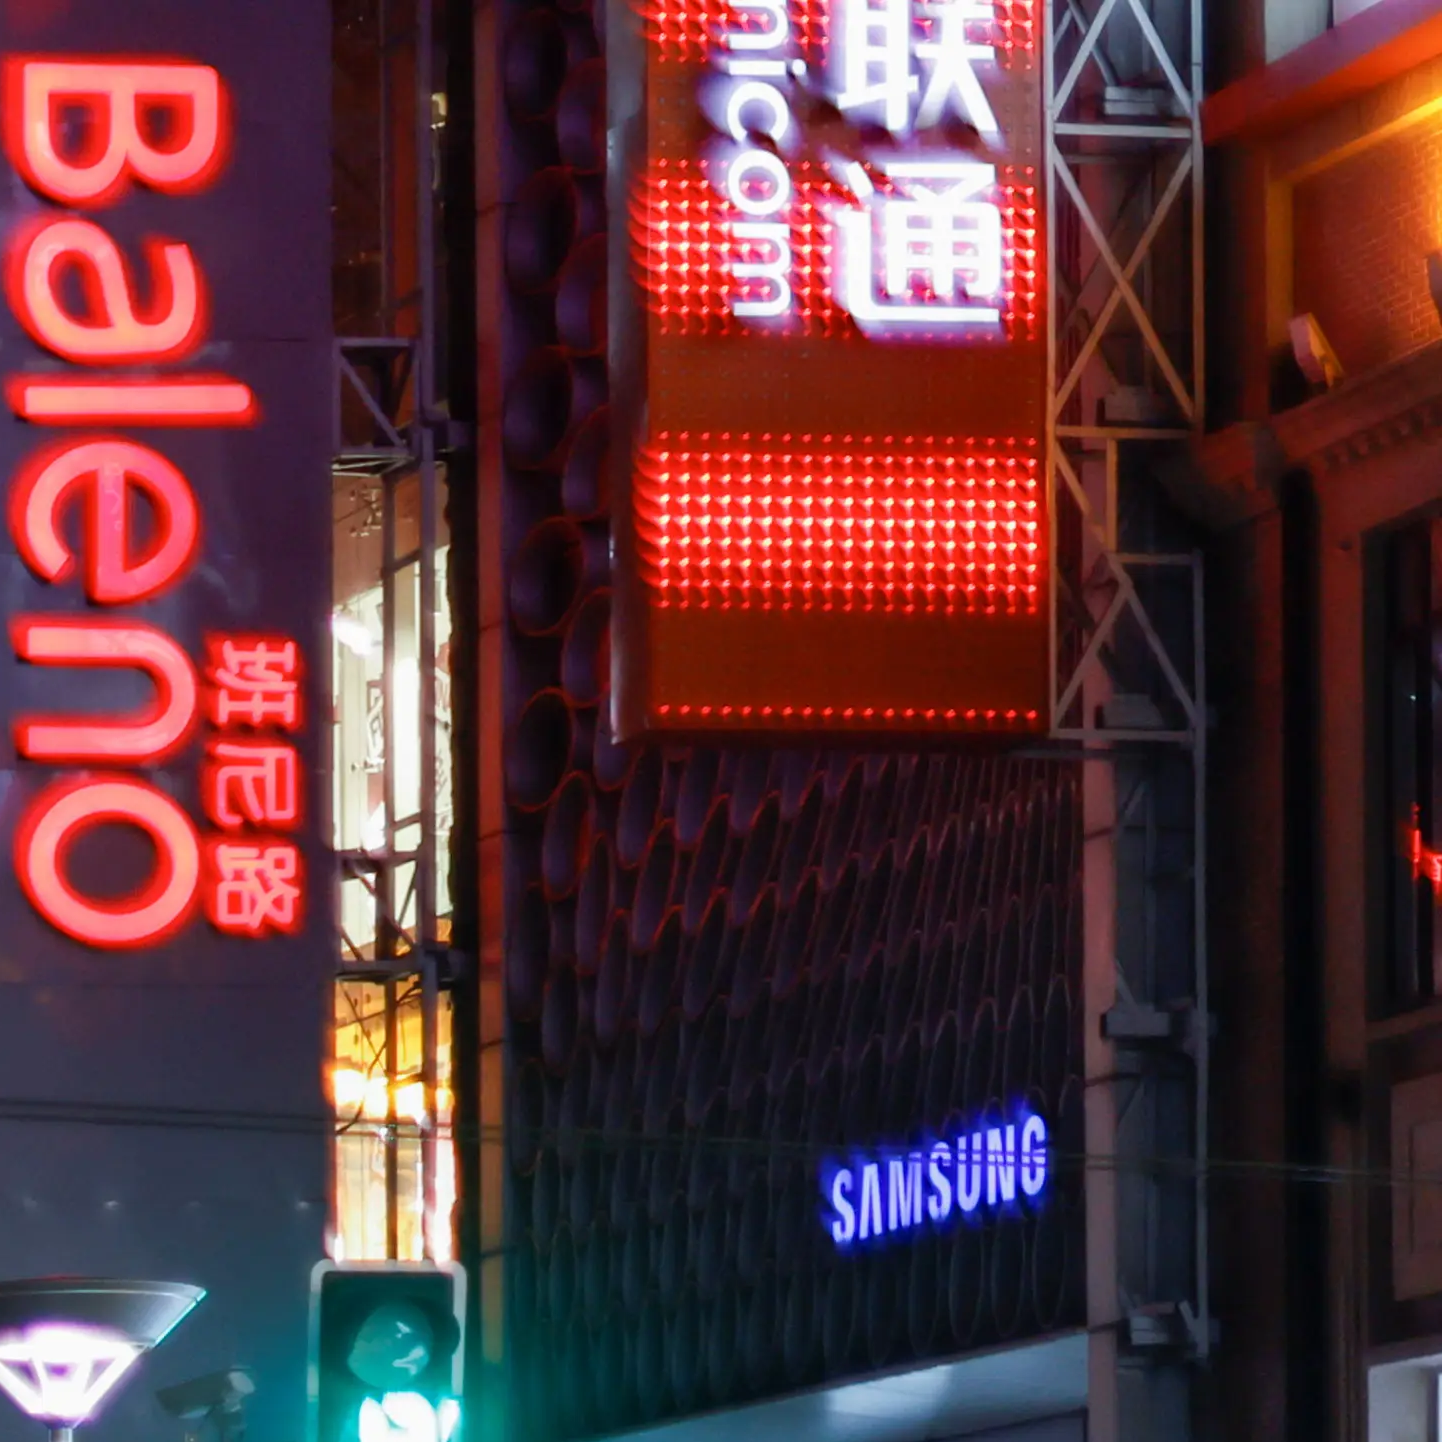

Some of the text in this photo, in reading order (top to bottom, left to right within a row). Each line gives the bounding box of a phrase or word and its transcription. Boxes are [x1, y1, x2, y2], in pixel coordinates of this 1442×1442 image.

[6, 56, 256, 948] Baleno
[209, 633, 303, 936] 班尼路
[831, 1114, 1049, 1246] SAMSUNG
